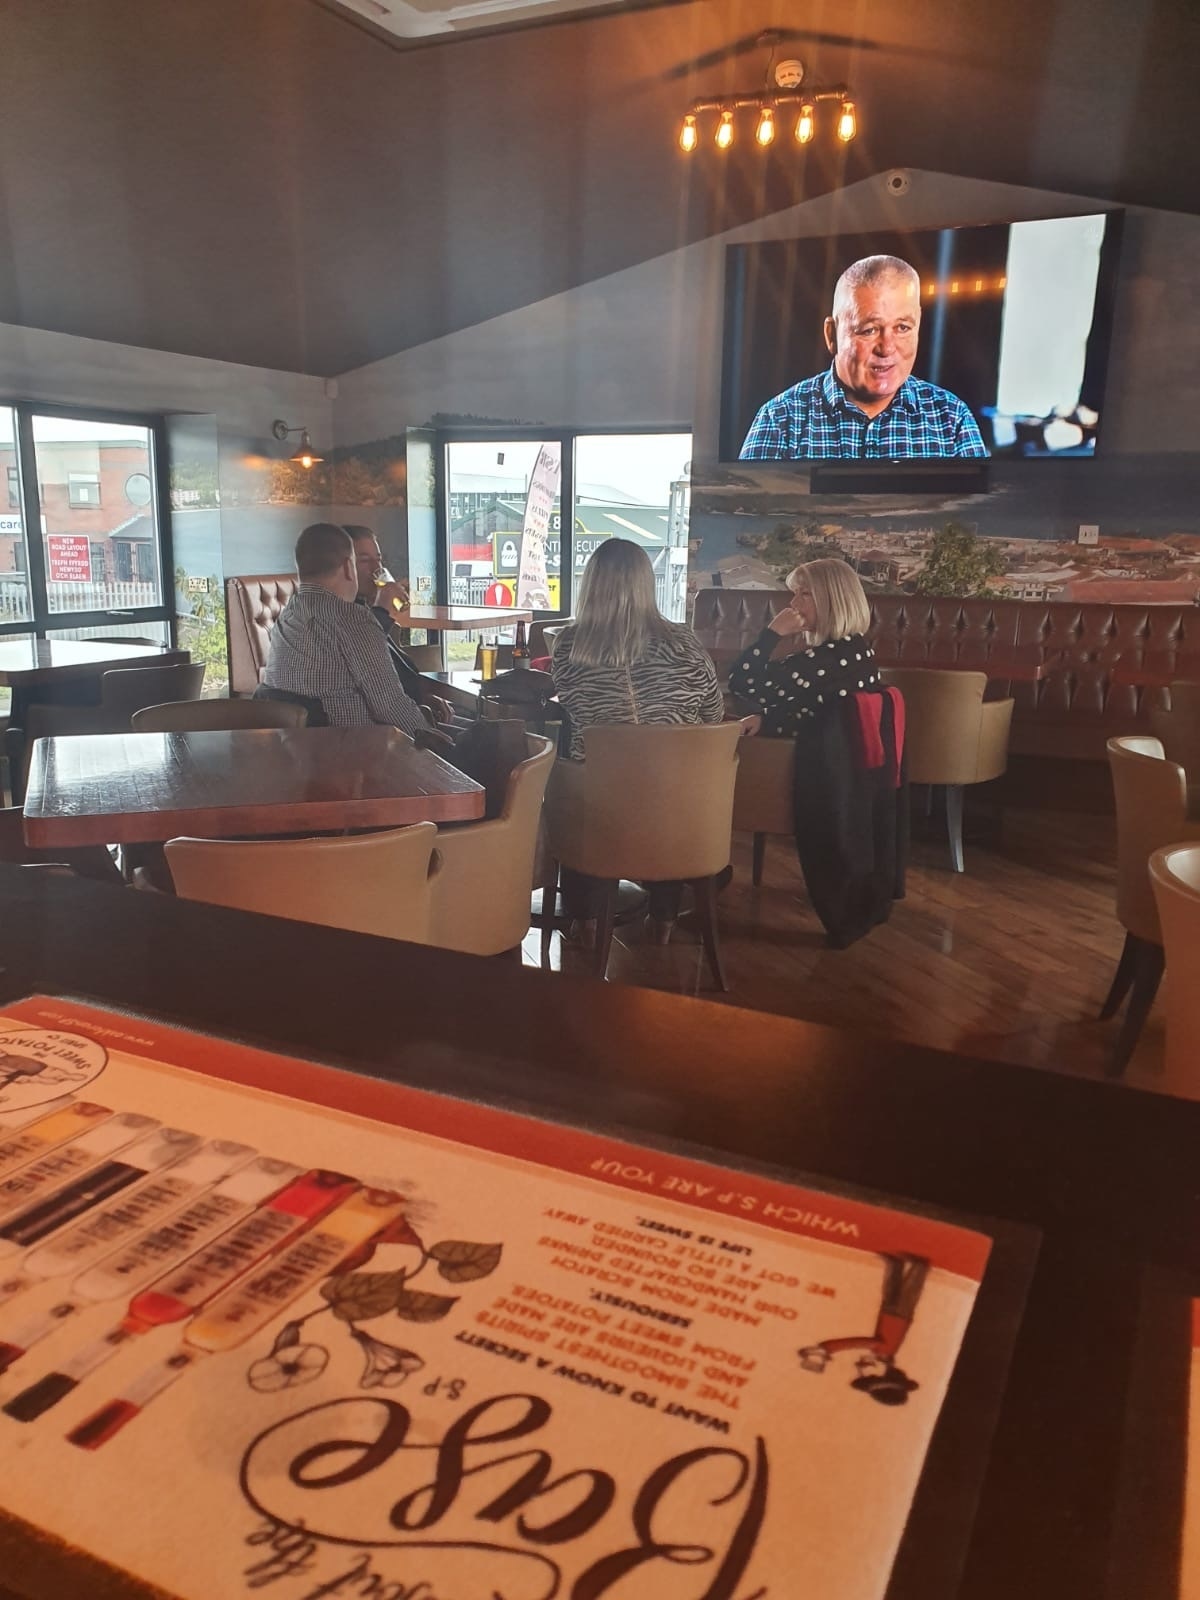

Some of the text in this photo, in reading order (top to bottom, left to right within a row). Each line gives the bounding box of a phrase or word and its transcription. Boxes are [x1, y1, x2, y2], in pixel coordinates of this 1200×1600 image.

[51, 1046, 92, 1070] SWEET
[588, 1155, 860, 1238] WHICH S.P ARE YOU?
[591, 1221, 668, 1250] CARRIED
[697, 1234, 715, 1246] IS
[718, 1239, 753, 1256] LIFE
[672, 1243, 734, 1269] LITTLE
[739, 1261, 751, 1273] A
[535, 1235, 799, 1321] OUR HANDCRAFTED DRINKS
[686, 1263, 717, 1280] SO
[721, 1273, 761, 1292] ARE
[755, 1267, 800, 1289] GOT
[548, 1255, 762, 1328] MADE FROM SCRATCH
[804, 1281, 837, 1299] WE
[490, 1295, 748, 1388] AND LIQUEURS ARE MADE
[614, 1318, 686, 1348] SWEET
[473, 1309, 740, 1410] THE SMOOTHEST SPIRITS
[690, 1341, 757, 1372] FROM
[452, 1329, 731, 1435] WANT TO KNOW A SECRET?
[259, 1393, 769, 1600] Base
[242, 1517, 317, 1589] the
